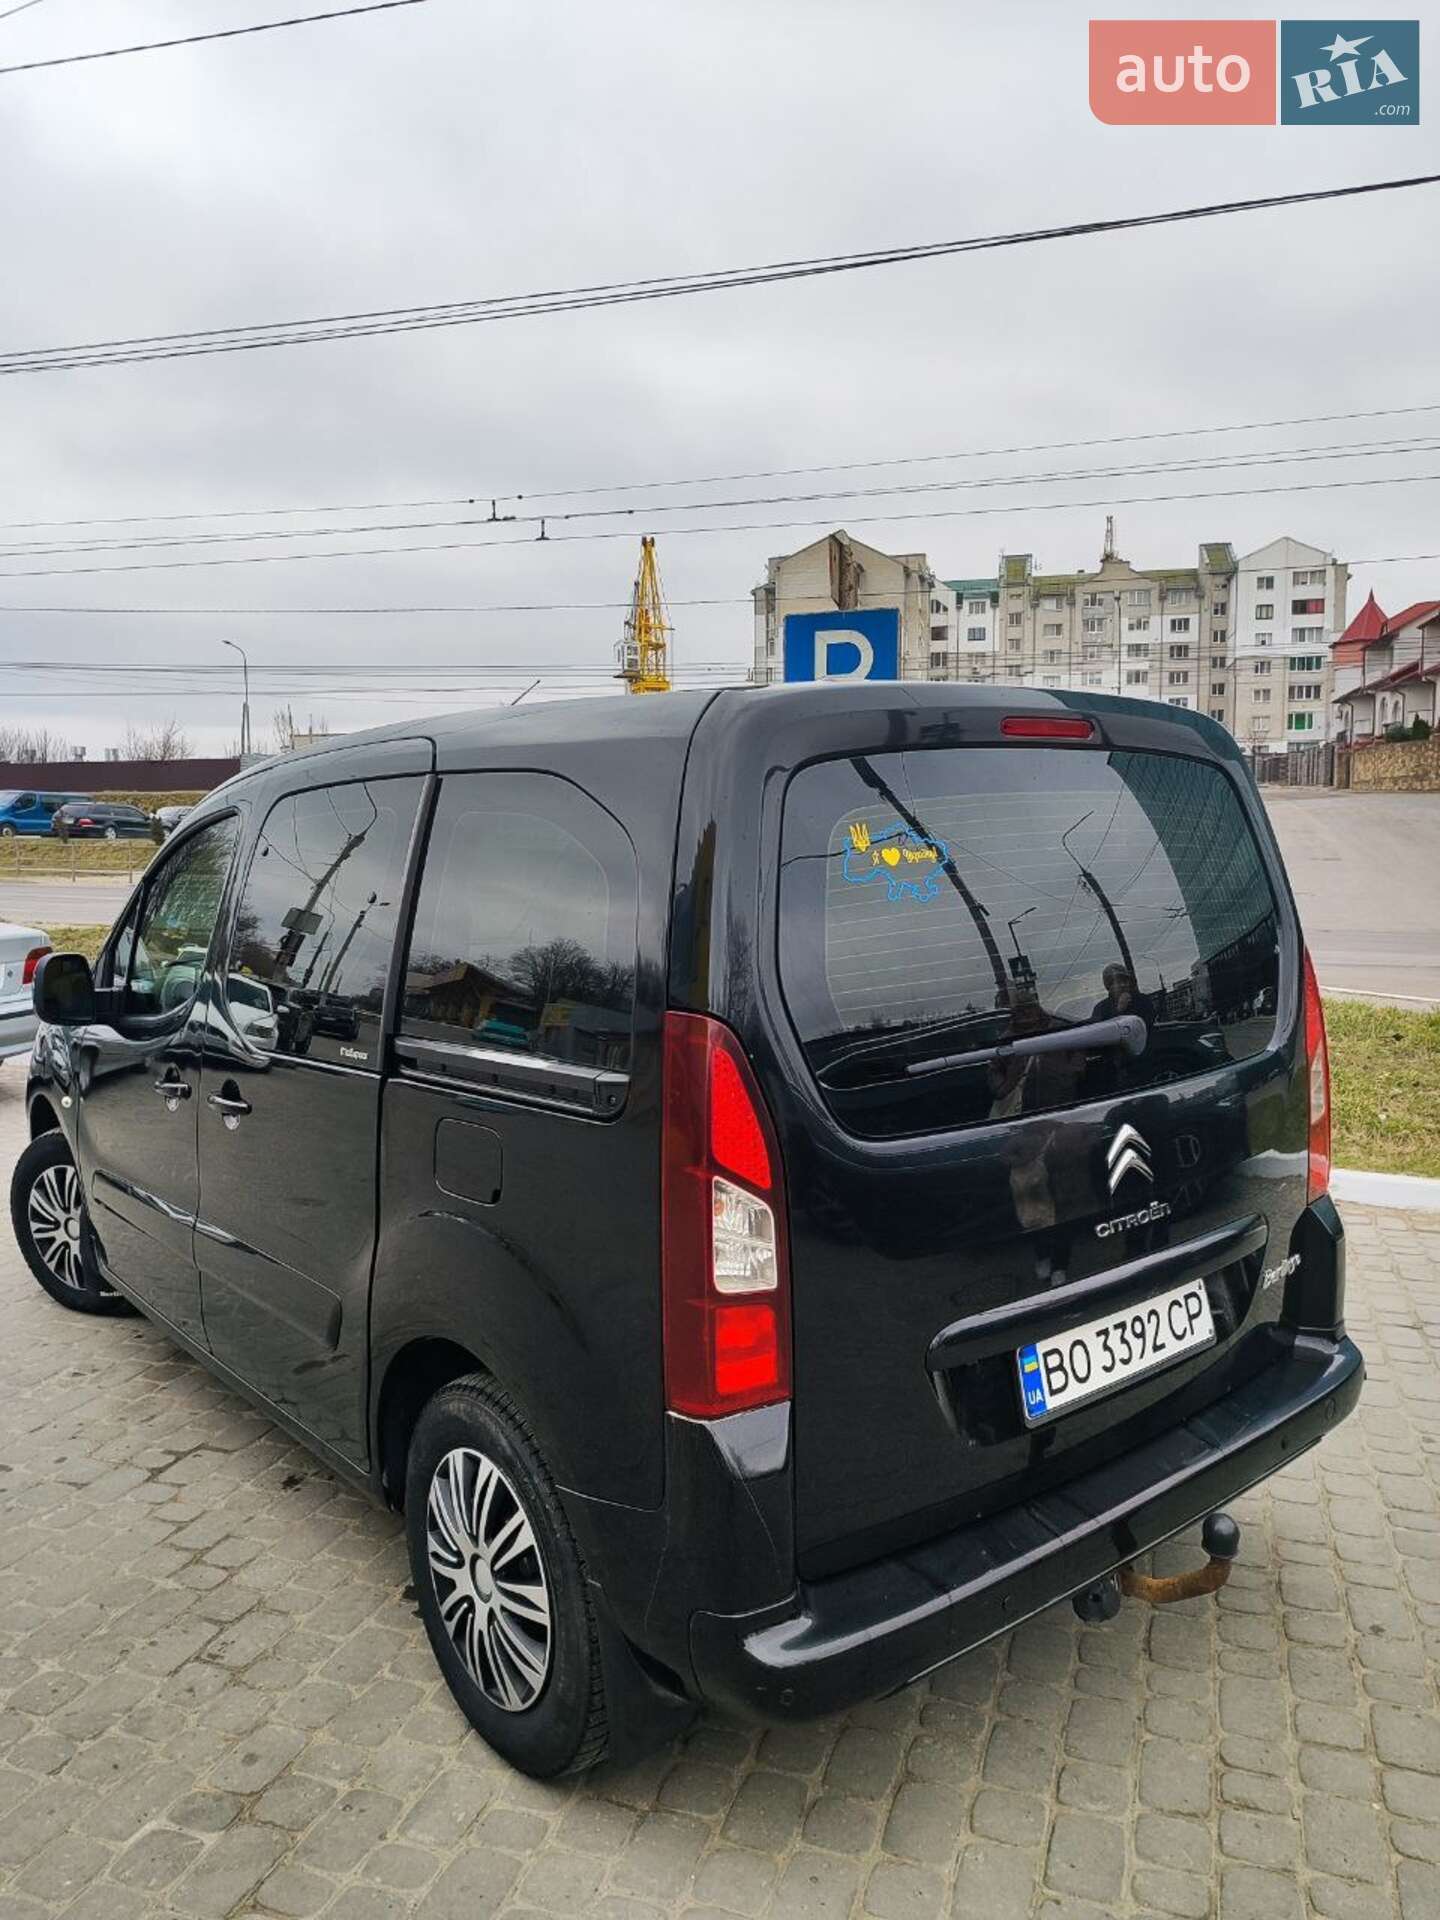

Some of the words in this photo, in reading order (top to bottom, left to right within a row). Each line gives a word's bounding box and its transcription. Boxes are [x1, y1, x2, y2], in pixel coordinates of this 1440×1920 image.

[1043, 1338, 1092, 1397] BO
[1095, 1308, 1166, 1374] 3392
[1166, 1291, 1203, 1341] CP
[1027, 1390, 1044, 1405] UA
